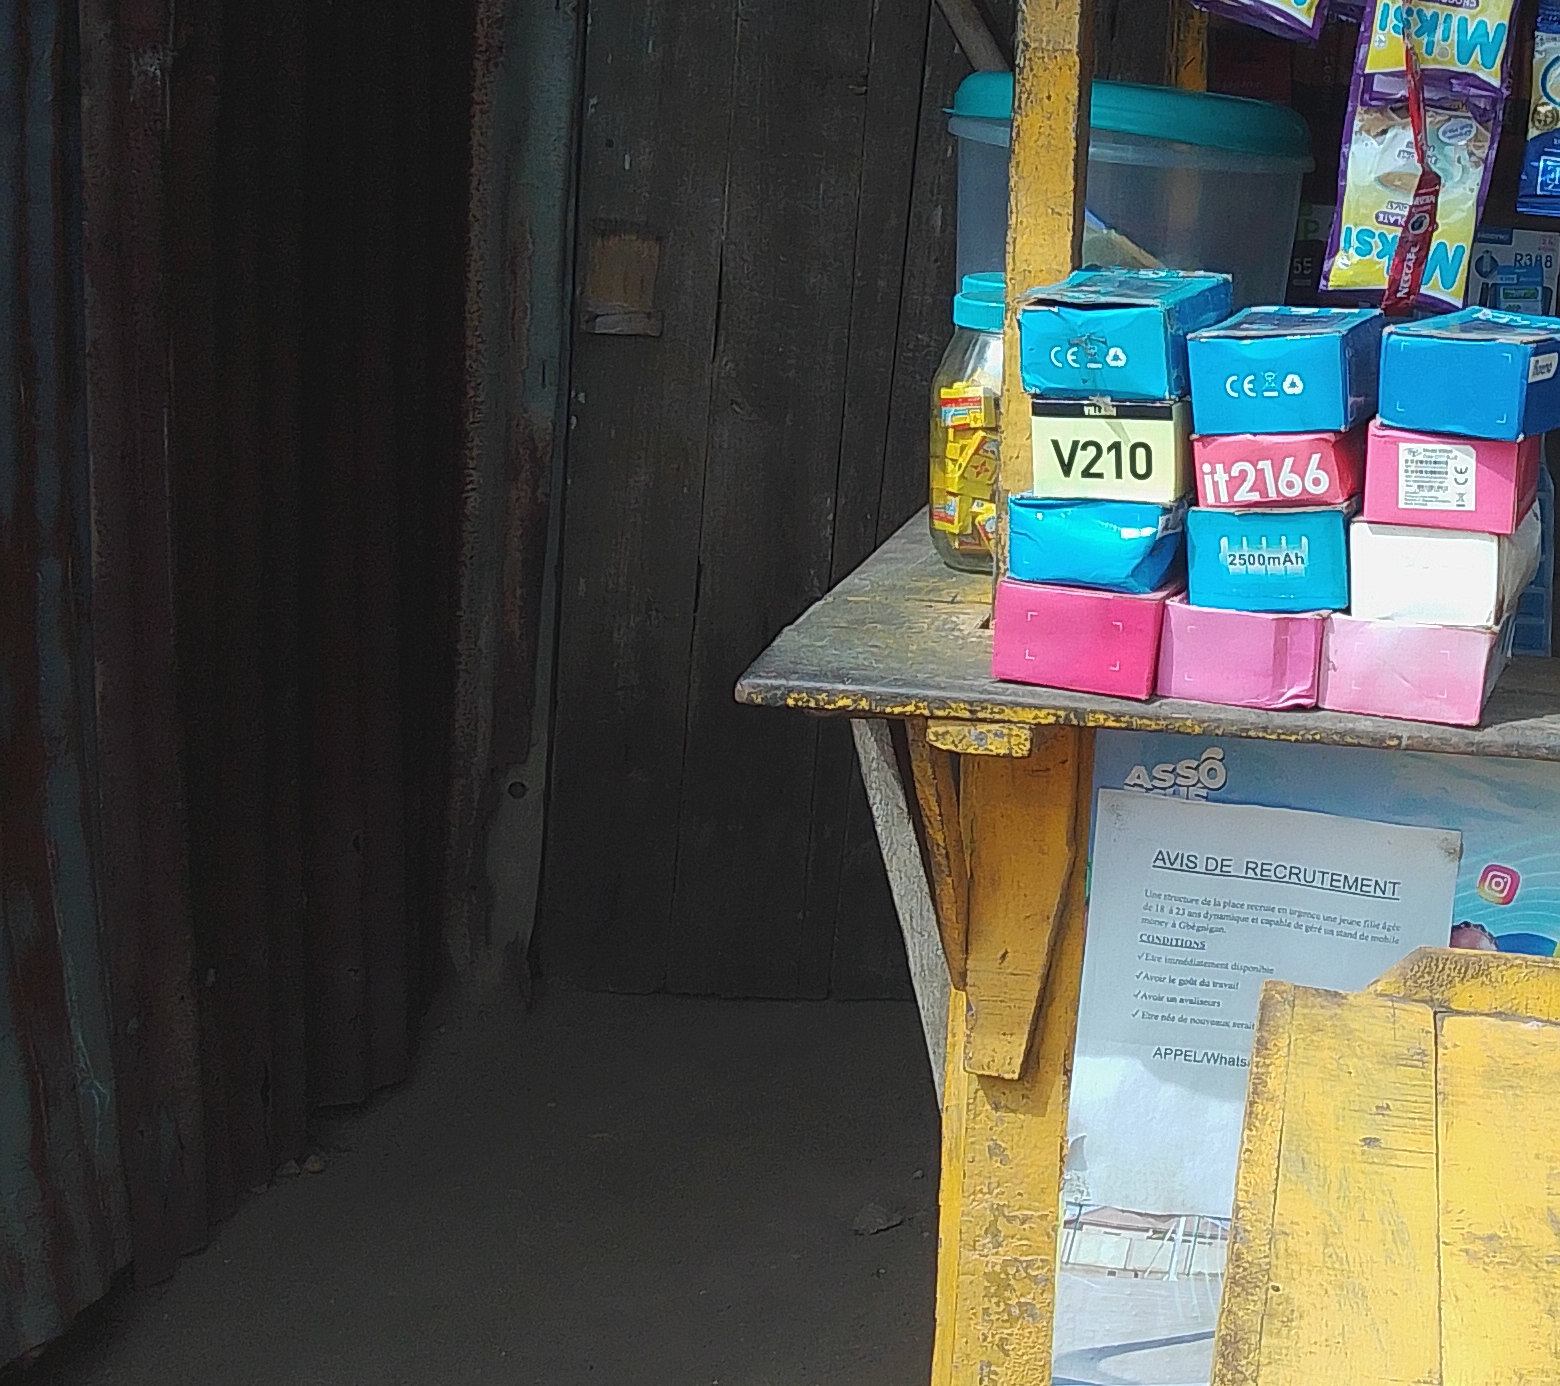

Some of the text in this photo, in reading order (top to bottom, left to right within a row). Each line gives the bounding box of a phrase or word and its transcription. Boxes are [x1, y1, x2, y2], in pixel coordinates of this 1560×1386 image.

[1374, 2, 1507, 70] Miksi
[1051, 438, 1153, 482] V210
[1201, 451, 1331, 504] it2166
[1226, 551, 1306, 569] 2500mAh
[1152, 849, 1401, 897] AVIS DE RECRUTEMENT
[1144, 889, 1162, 900] Une
[1222, 899, 1245, 911] place
[1187, 910, 1202, 918] ans
[1260, 915, 1292, 929] capable
[1336, 926, 1357, 939] stand
[1139, 933, 1206, 950] CONDITIONS
[1142, 972, 1166, 983] Avoir
[1169, 975, 1176, 984] le
[1141, 991, 1165, 1002] Avoir
